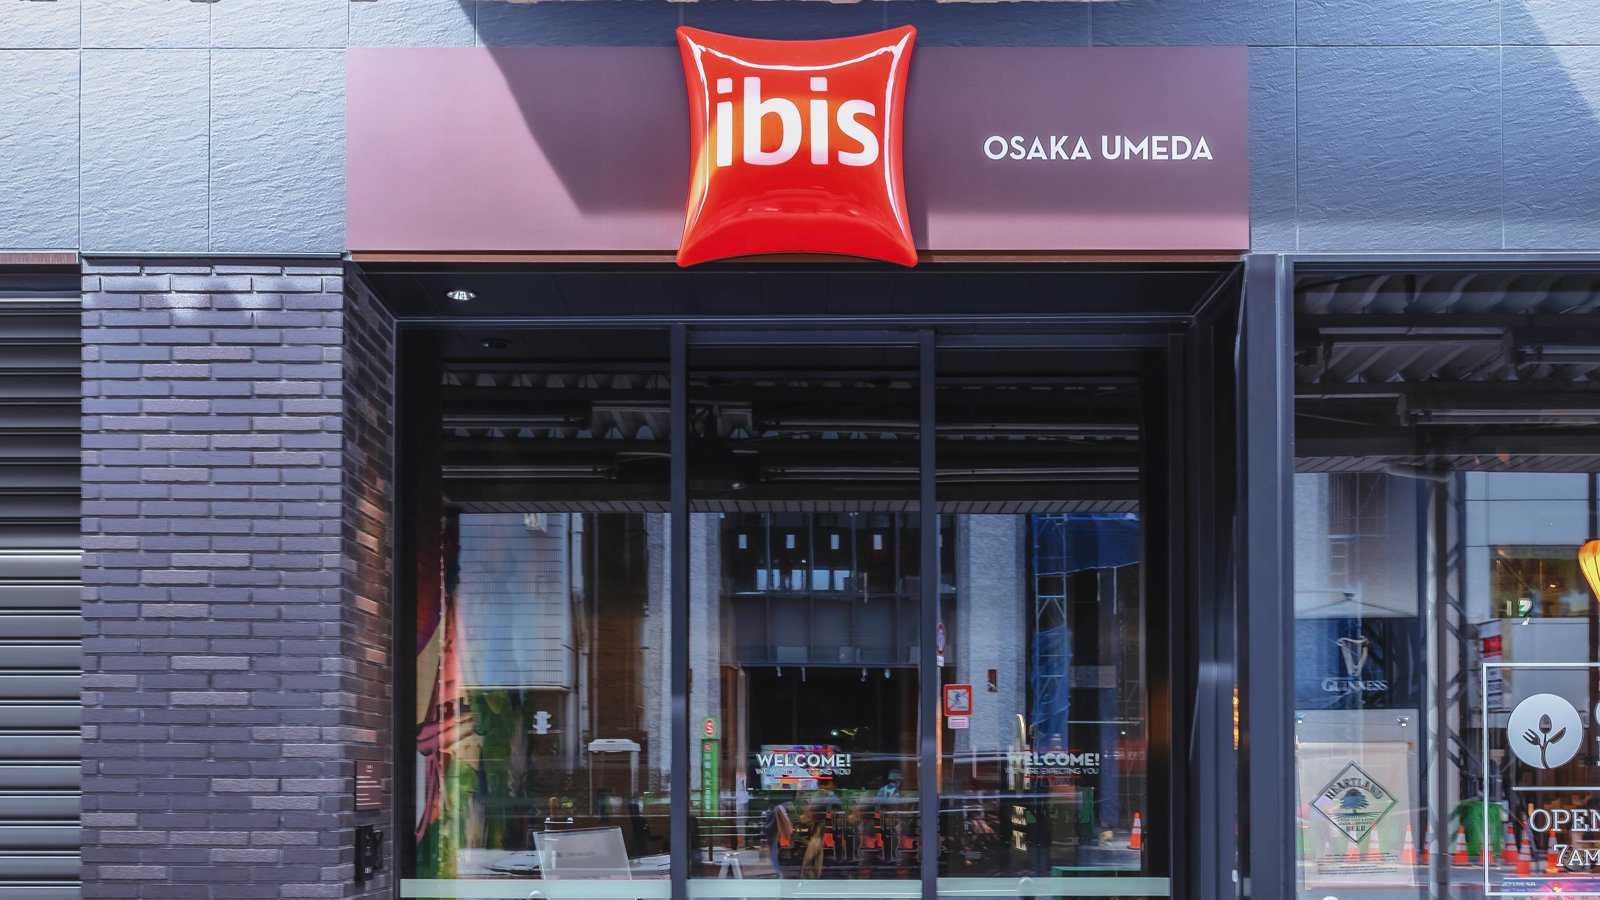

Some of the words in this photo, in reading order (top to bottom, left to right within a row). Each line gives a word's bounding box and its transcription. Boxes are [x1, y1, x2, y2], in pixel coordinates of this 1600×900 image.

[716, 76, 879, 167] ibis
[983, 135, 1092, 161] OSAKA
[1102, 135, 1214, 161] UMEDA
[1321, 679, 1389, 692] GUINNESS
[756, 753, 851, 766] WELCOME!
[1082, 767, 1099, 775] YOU
